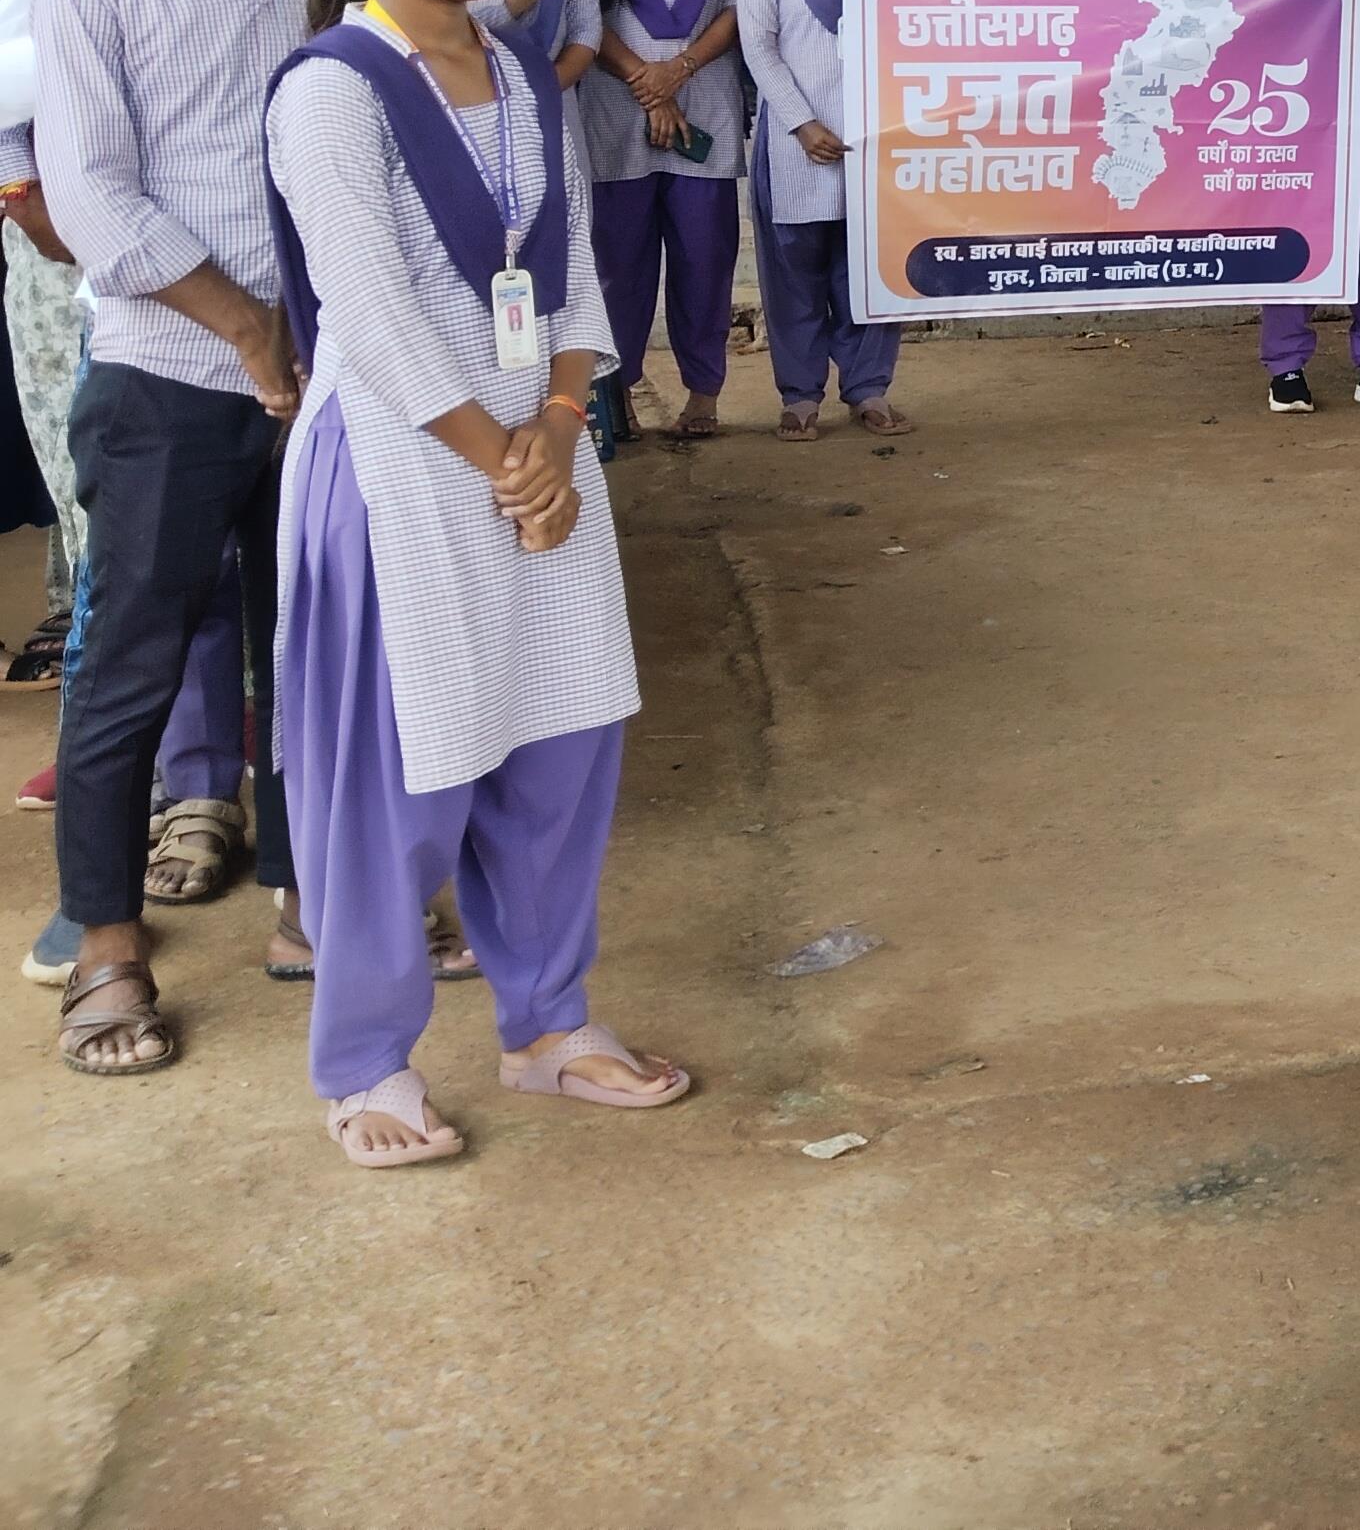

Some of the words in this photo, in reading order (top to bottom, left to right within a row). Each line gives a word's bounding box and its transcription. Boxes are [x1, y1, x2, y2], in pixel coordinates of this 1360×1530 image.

[892, 61, 1083, 137] रजत
[1206, 57, 1311, 138] 25
[891, 133, 1081, 194] महोत्सव
[1229, 145, 1252, 164] का
[1254, 145, 1299, 164] उत्सव
[1235, 173, 1259, 191] का
[1260, 169, 1314, 191] संकल्प
[969, 243, 1012, 261] डारन
[1096, 235, 1174, 256] शासकीय
[1176, 233, 1278, 253] महाविद्यालय
[1039, 264, 1090, 284] जिला
[1104, 260, 1160, 282] बालोद
